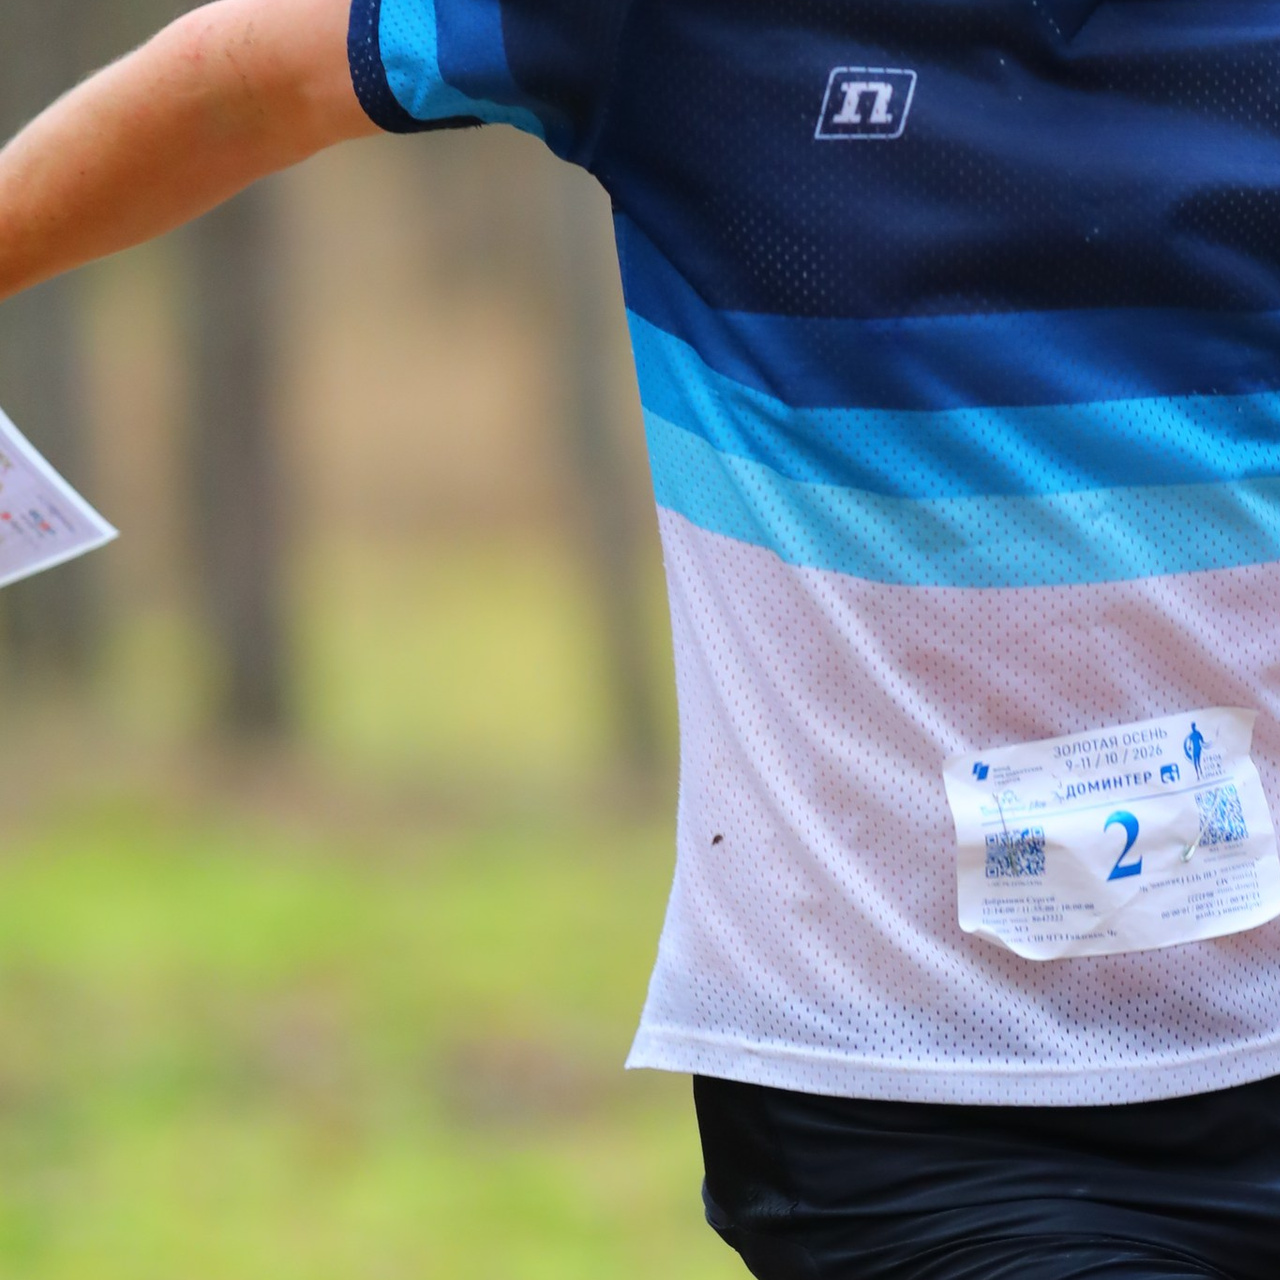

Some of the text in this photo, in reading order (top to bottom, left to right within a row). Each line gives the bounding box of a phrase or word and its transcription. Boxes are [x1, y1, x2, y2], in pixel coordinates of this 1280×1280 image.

[1053, 727, 1168, 758] ЗОЛОТАЯ ОСЕНЬ
[1106, 751, 1118, 765] 10
[1066, 771, 1152, 799] ДОМИНТЕР
[1103, 809, 1144, 882] 2
